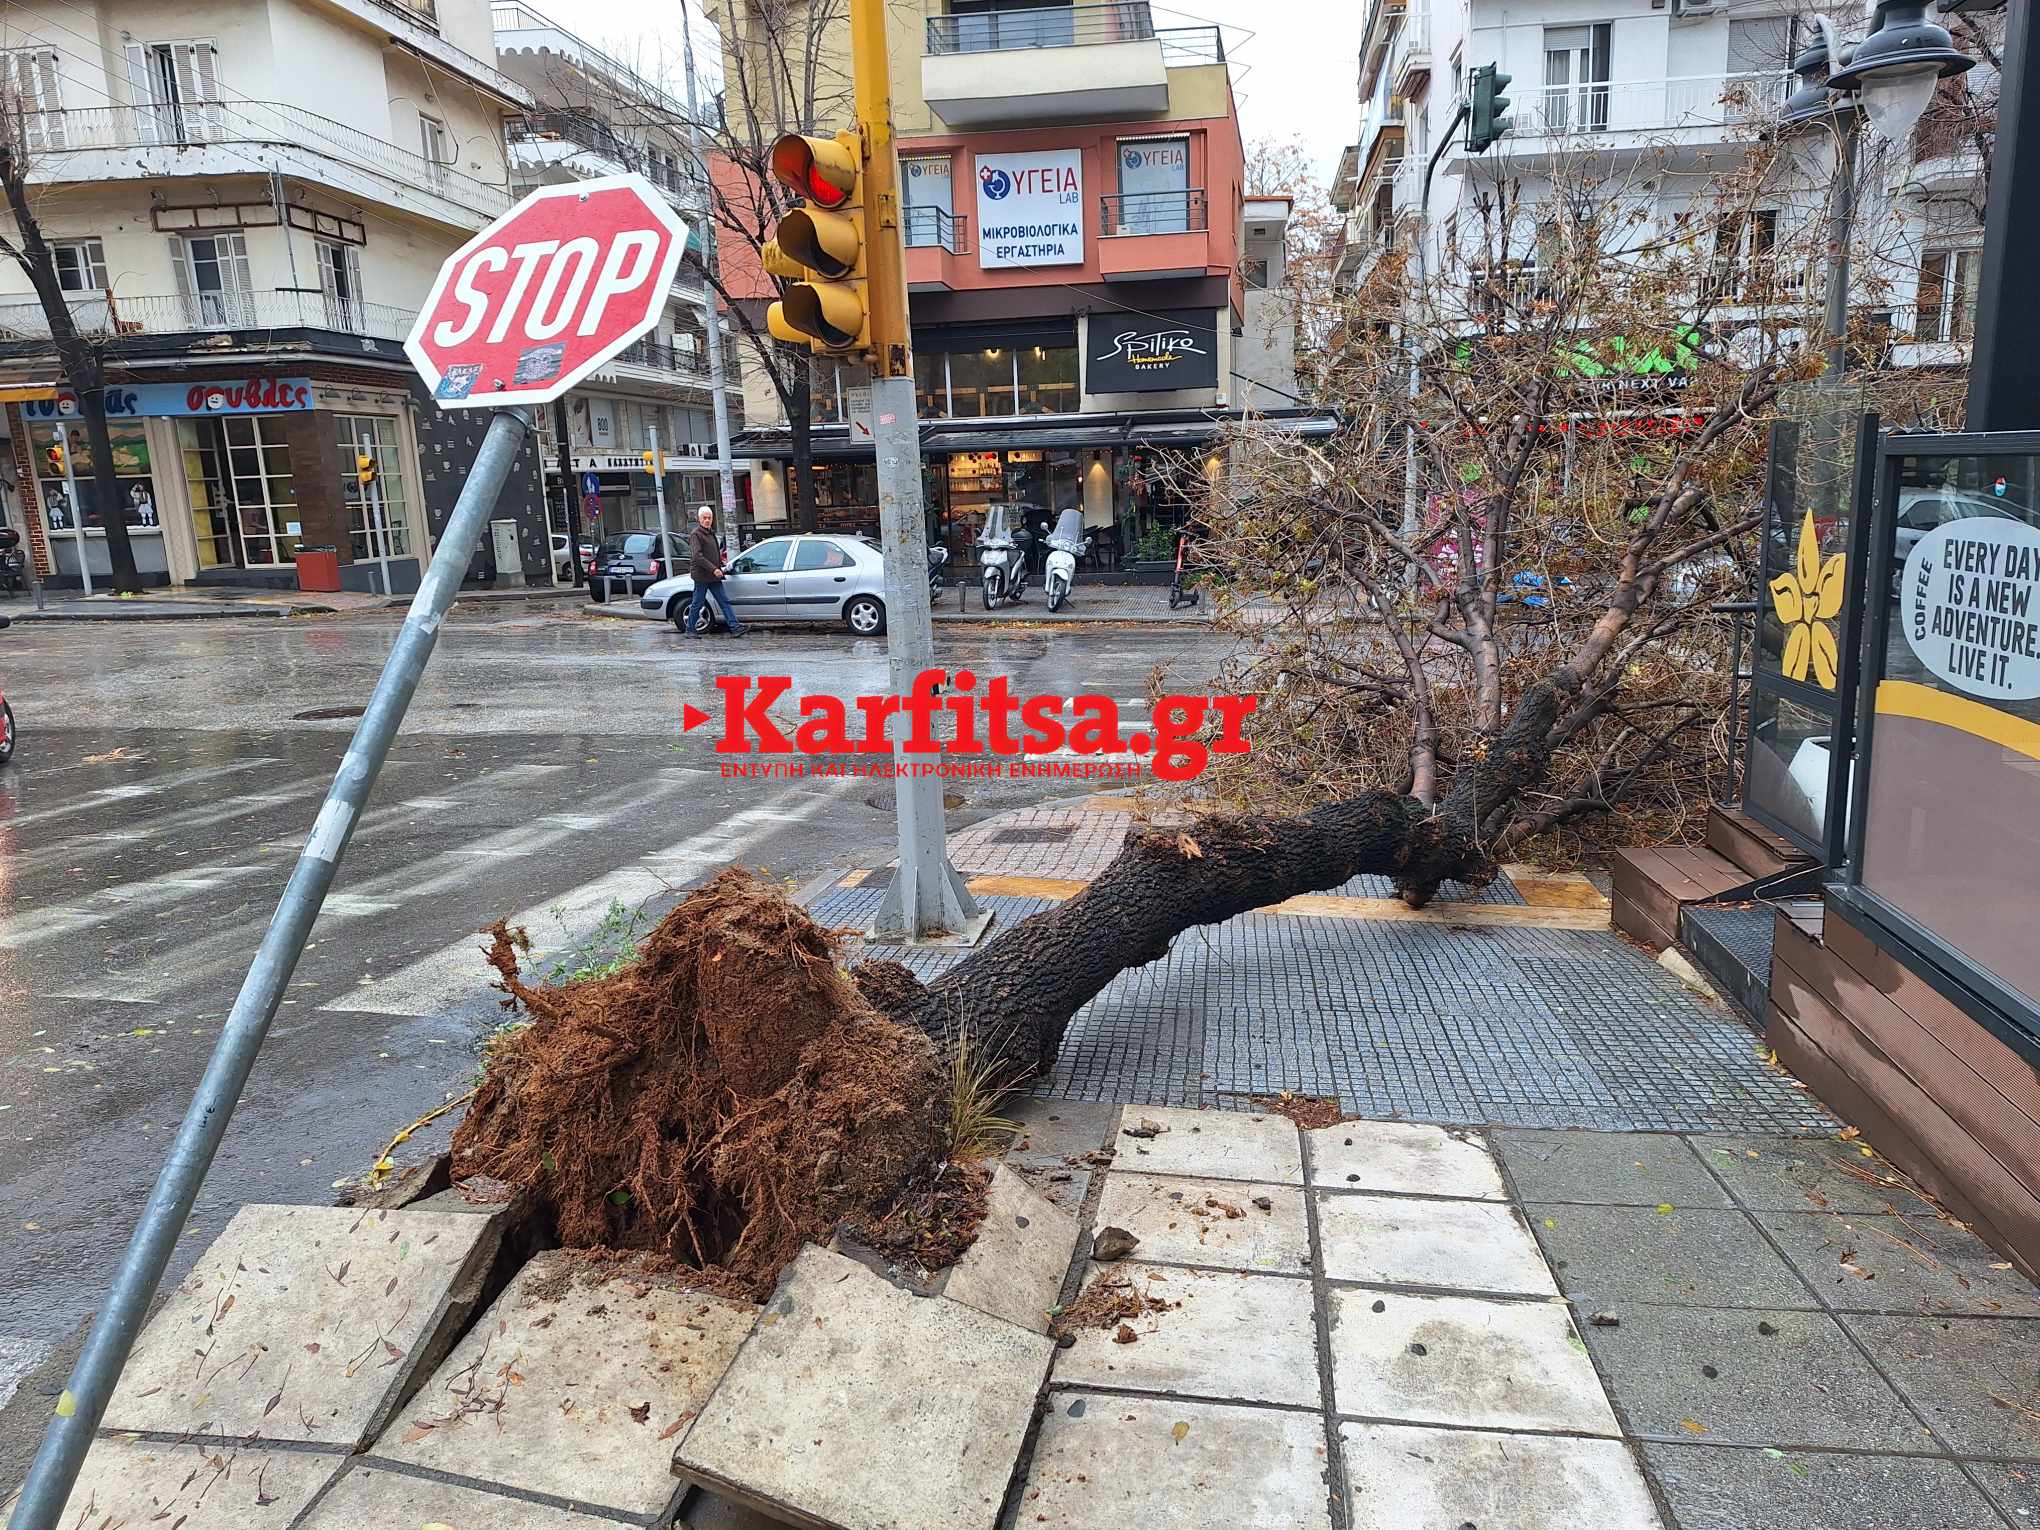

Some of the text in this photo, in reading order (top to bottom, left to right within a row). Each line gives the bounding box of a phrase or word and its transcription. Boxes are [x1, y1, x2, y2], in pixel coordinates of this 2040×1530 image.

[922, 163, 950, 176] ΥΓΕΙΑ
[1143, 149, 1184, 167] ΥΓΕΙΑ
[1011, 167, 1079, 195] ΥΓΕΙΑ
[1059, 192, 1079, 205] LAB
[982, 223, 1078, 240] ΜΙΚΡΟΒΙΟΛΟΓΙΚΑ
[996, 243, 1065, 259] ΕΡΓΑΣΤΗΡΙΑ
[433, 229, 661, 348] STOP
[1135, 362, 1170, 370] BAKERY
[1618, 379, 1658, 390] NEXT
[1943, 538, 2001, 575] EVERY
[1914, 556, 1933, 641] COFFEE
[1948, 573, 2032, 618] IS A NEW
[1931, 605, 2040, 660] ADVENTURE.
[1948, 642, 2013, 690] LIVE IT.
